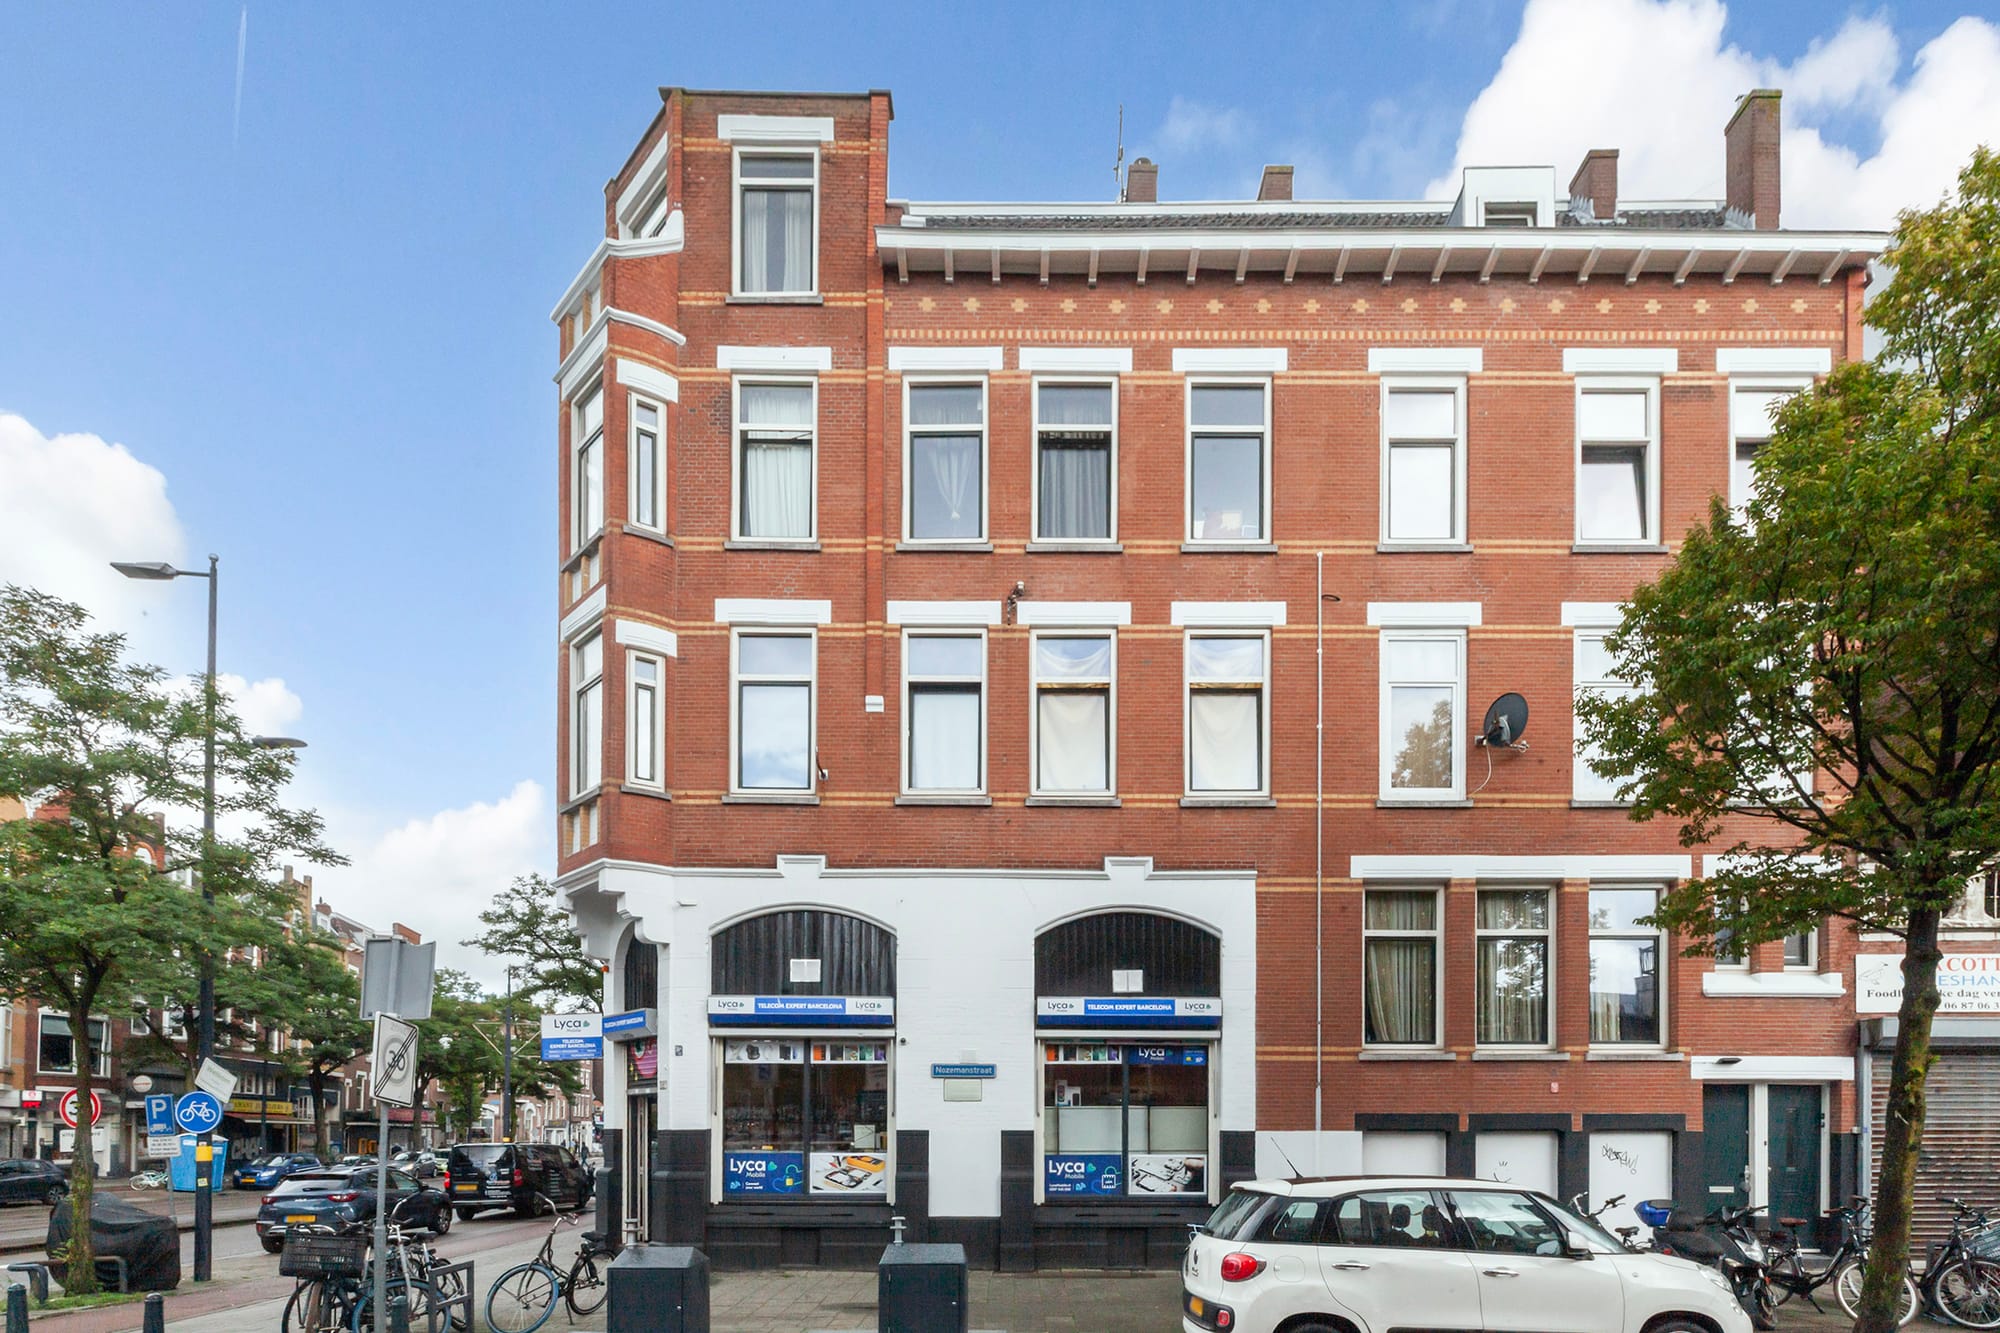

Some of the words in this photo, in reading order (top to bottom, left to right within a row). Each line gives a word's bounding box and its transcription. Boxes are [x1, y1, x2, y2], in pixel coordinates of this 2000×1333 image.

[1938, 957, 2000, 971] COTT
[1957, 989, 1979, 998] dag
[718, 1000, 738, 1009] Lyca
[856, 1001, 876, 1010] Lyca
[1048, 1001, 1068, 1010] Lyca
[1185, 1001, 1205, 1010] Lyca
[554, 1019, 581, 1030] Lyca
[1139, 1048, 1165, 1058] Lyca
[935, 1066, 992, 1074] Nozemanstraat
[730, 1158, 766, 1174] Lyca
[1049, 1160, 1085, 1175] Lyca
